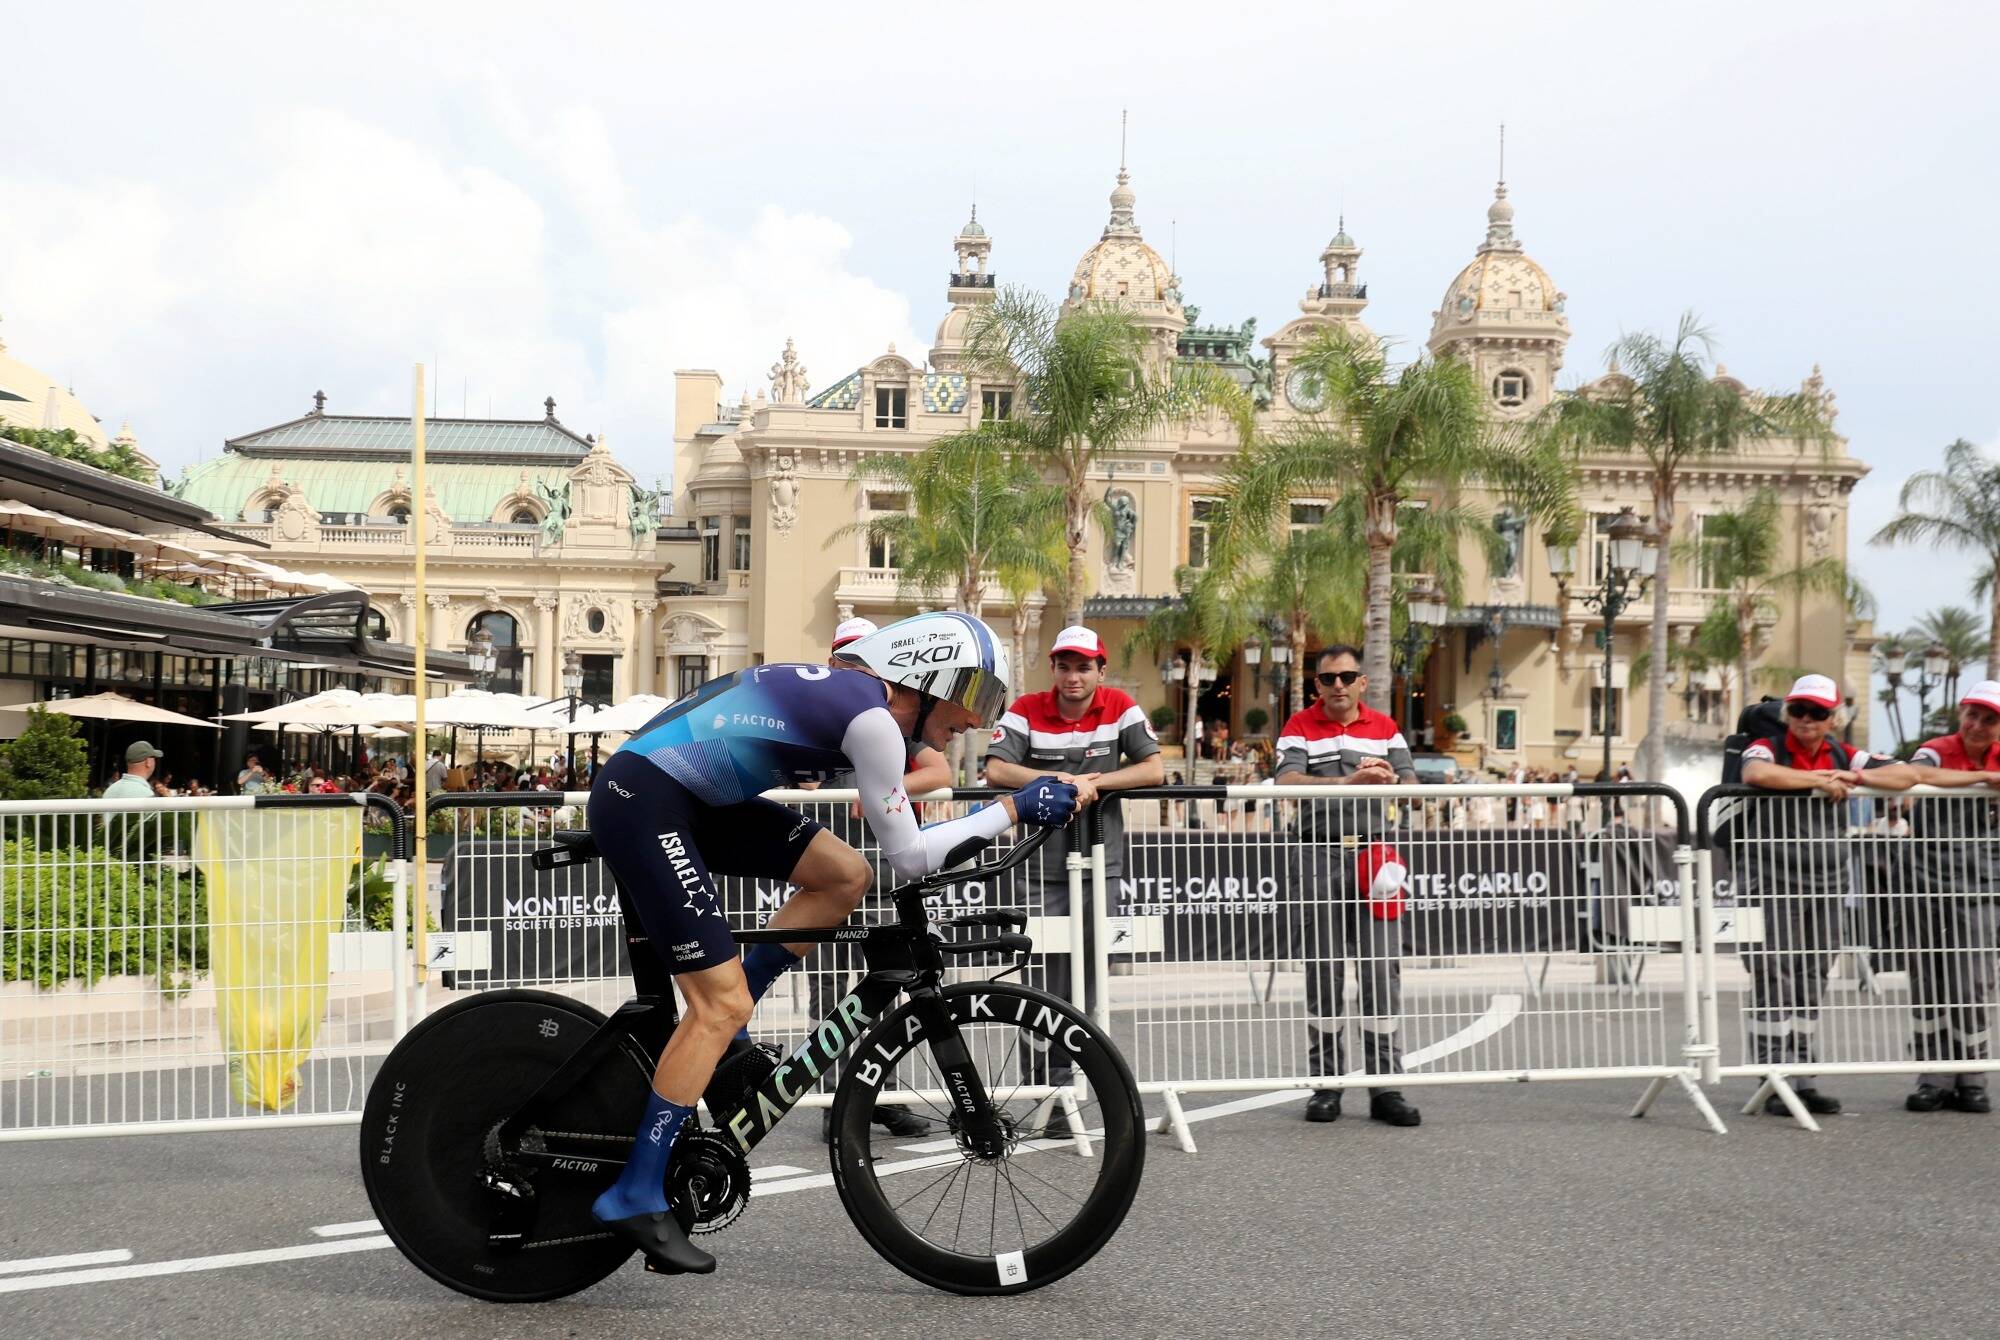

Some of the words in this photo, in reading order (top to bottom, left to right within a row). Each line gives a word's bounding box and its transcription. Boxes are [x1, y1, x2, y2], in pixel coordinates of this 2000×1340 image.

[891, 638, 915, 649] ISRAEL
[733, 713, 786, 731] FACTOR
[658, 831, 700, 889] ISRAEL
[927, 909, 947, 920] DE
[1141, 904, 1169, 915] DES
[1175, 904, 1219, 914] BAINS
[1225, 904, 1243, 914] DE
[1249, 904, 1278, 914] MER
[560, 918, 582, 929] DES
[586, 916, 617, 928] BAINS
[672, 941, 699, 951] RACING
[676, 950, 705, 961] CHANGE
[1015, 998, 1092, 1052] INC
[729, 993, 873, 1153] FACTOR
[951, 1071, 975, 1113] FACTOR
[380, 1114, 399, 1164] BLACK
[392, 1081, 406, 1107] INC
[552, 1158, 598, 1172] FACTOR
